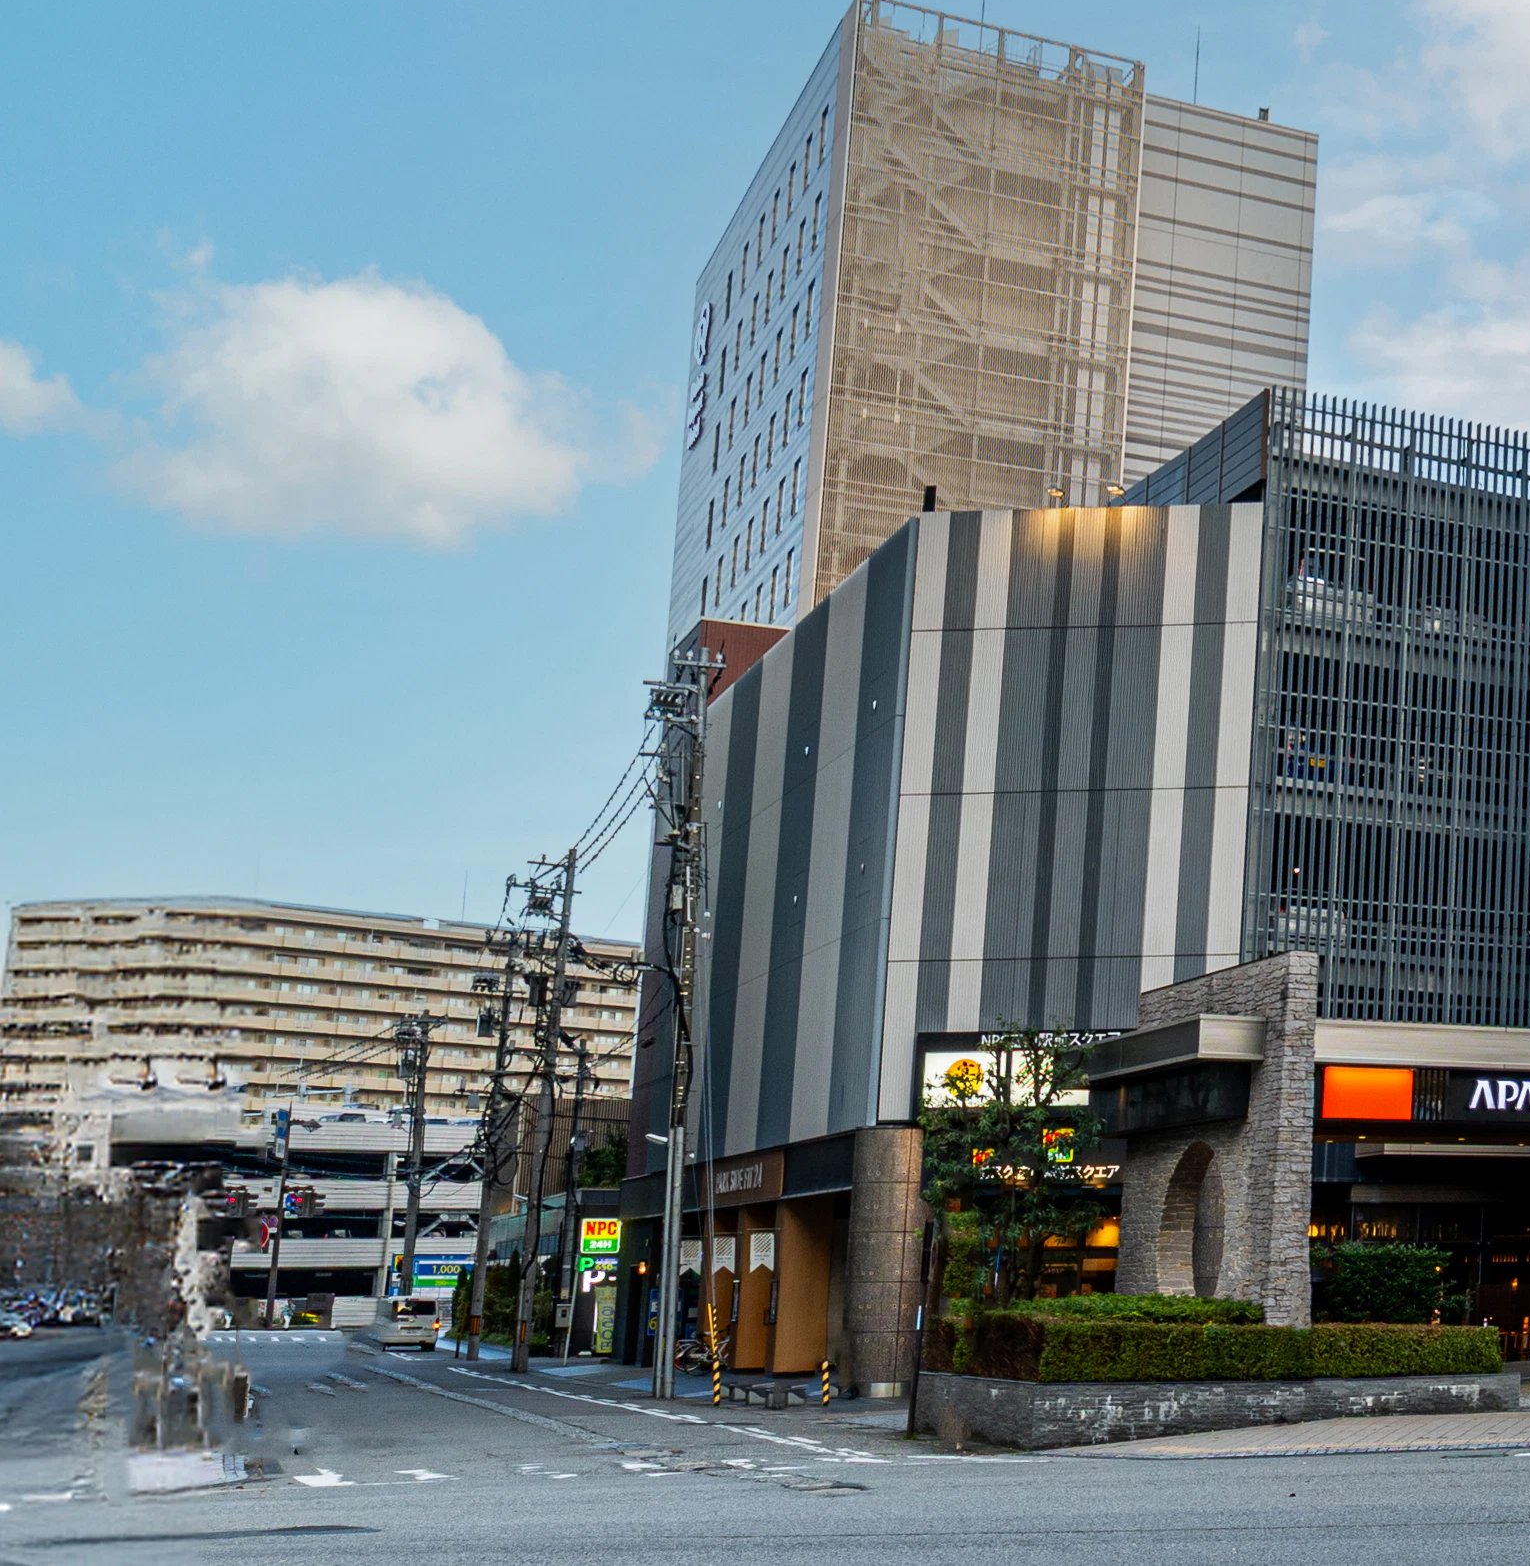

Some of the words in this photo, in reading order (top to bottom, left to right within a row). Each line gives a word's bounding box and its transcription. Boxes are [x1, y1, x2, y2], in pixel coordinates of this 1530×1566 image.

[586, 1221, 617, 1235] NPC
[589, 1240, 612, 1249] 24H
[432, 1265, 460, 1274] 1,000
